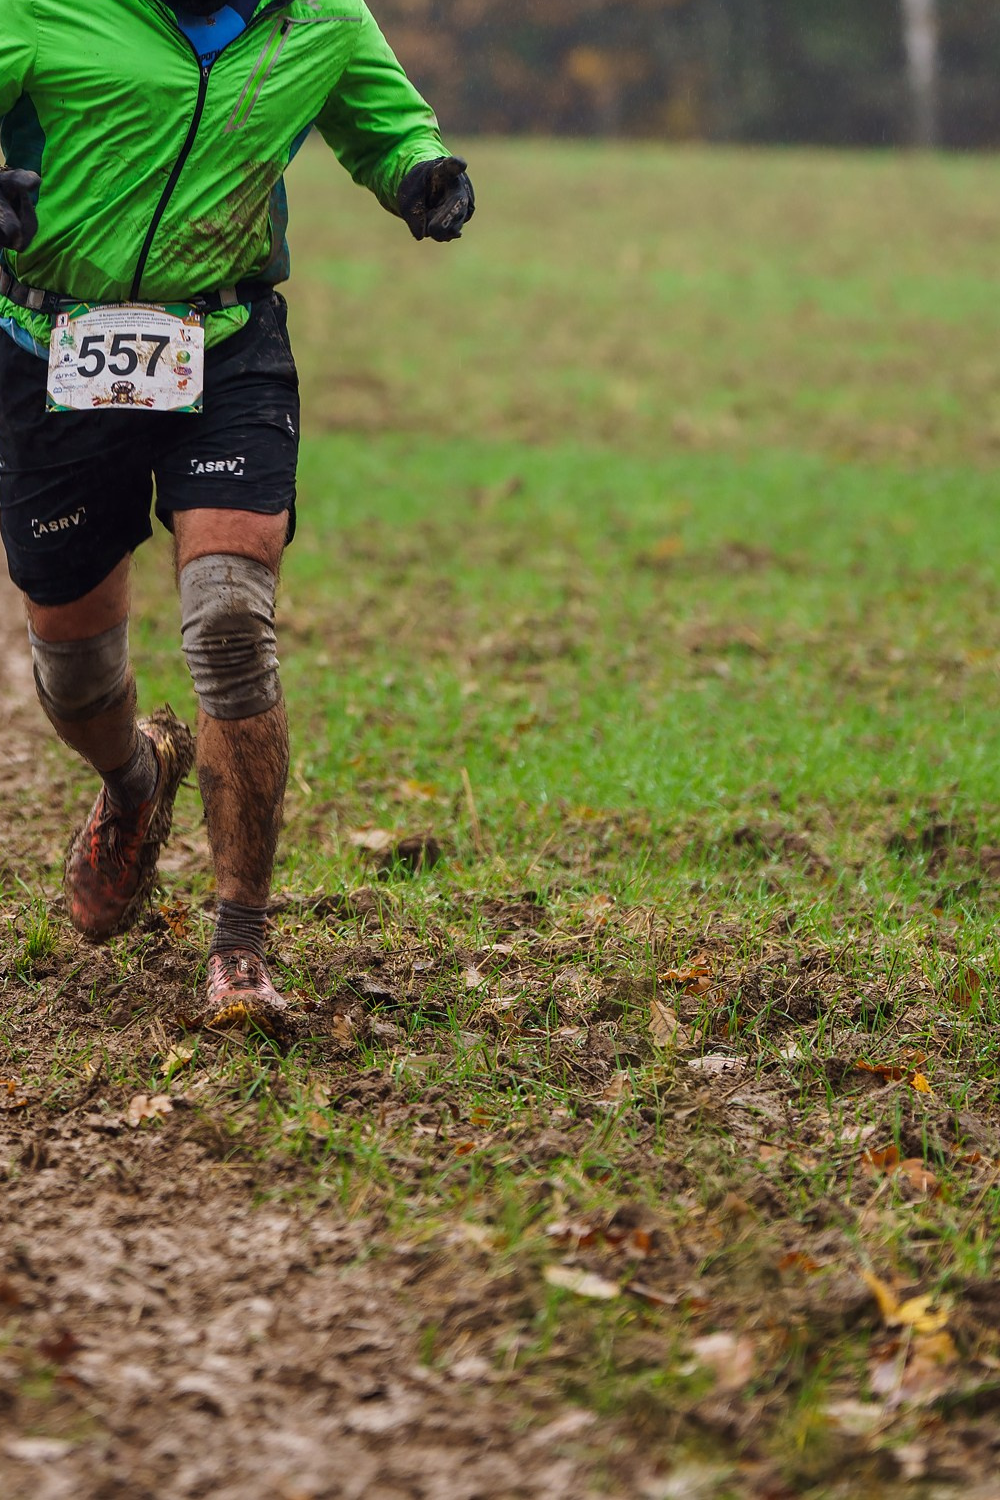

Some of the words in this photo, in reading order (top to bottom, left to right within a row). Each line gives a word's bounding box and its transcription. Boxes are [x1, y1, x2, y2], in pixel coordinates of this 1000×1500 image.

[77, 334, 170, 378] 557
[195, 459, 239, 475] ASRV
[37, 511, 81, 534] ASRV
